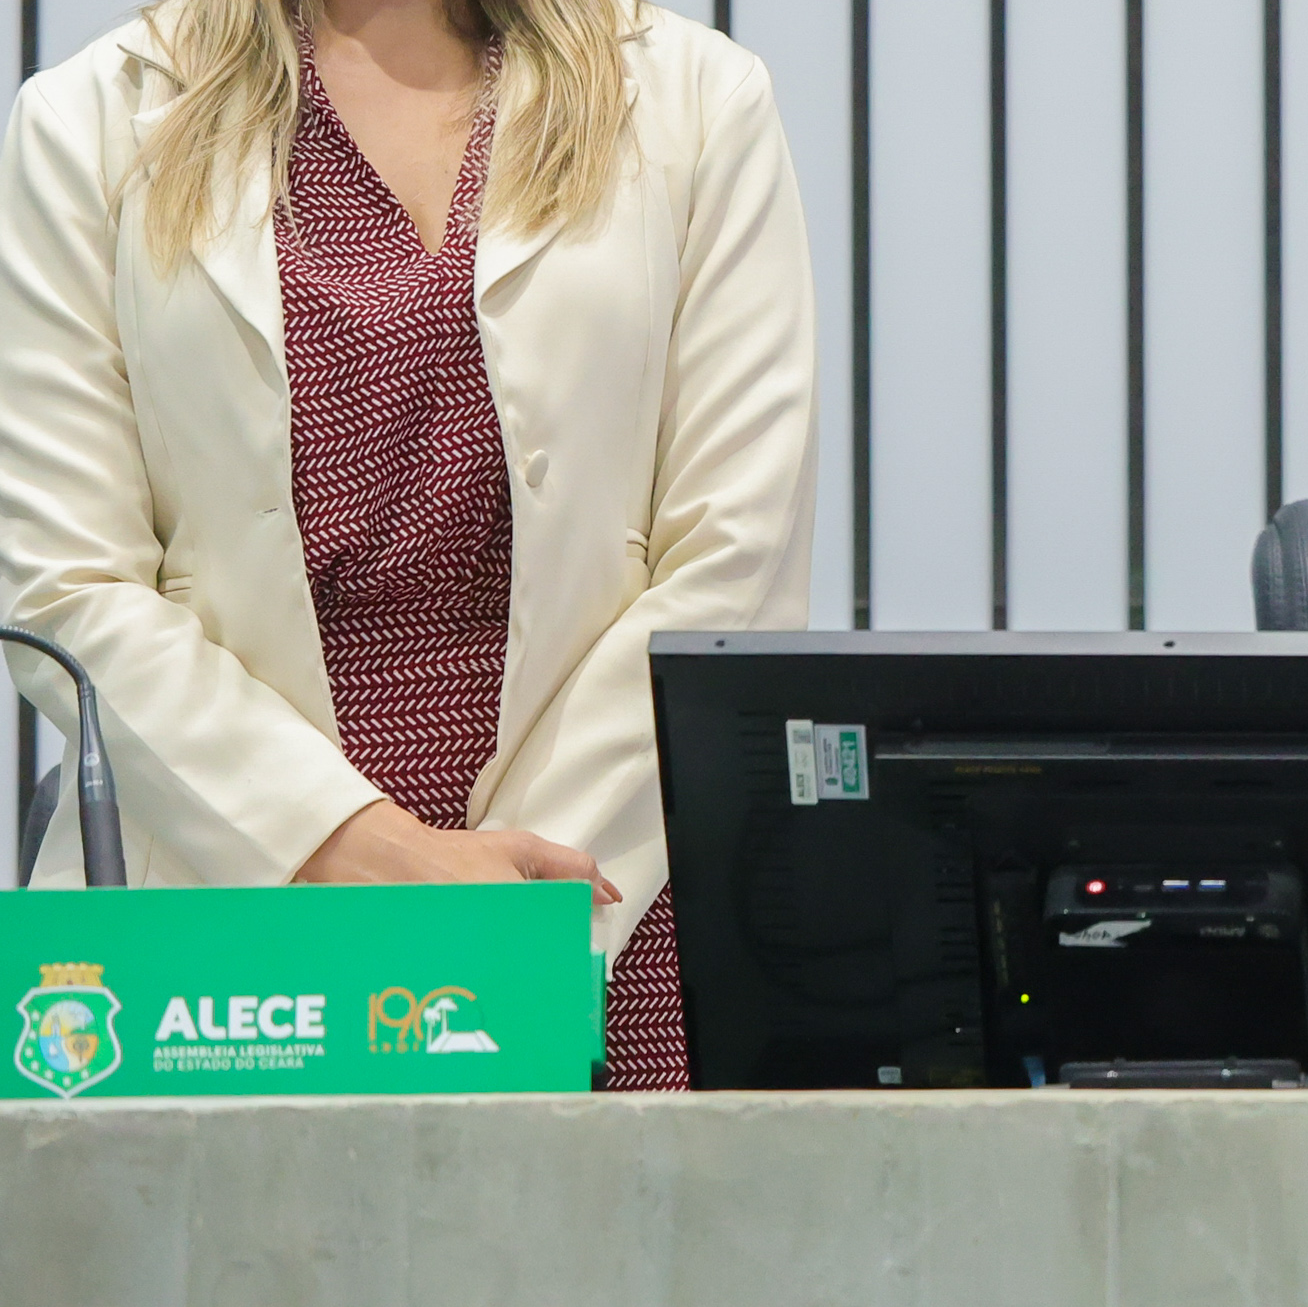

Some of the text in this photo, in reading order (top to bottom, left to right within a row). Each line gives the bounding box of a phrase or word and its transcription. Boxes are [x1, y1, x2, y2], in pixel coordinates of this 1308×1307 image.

[155, 994, 327, 1041] ALECE
[153, 1044, 325, 1059] ASSEMBLEIA LEGISLATIVA
[153, 1058, 174, 1072] DO
[177, 1058, 231, 1072] ESTADO
[234, 1057, 255, 1071] DO
